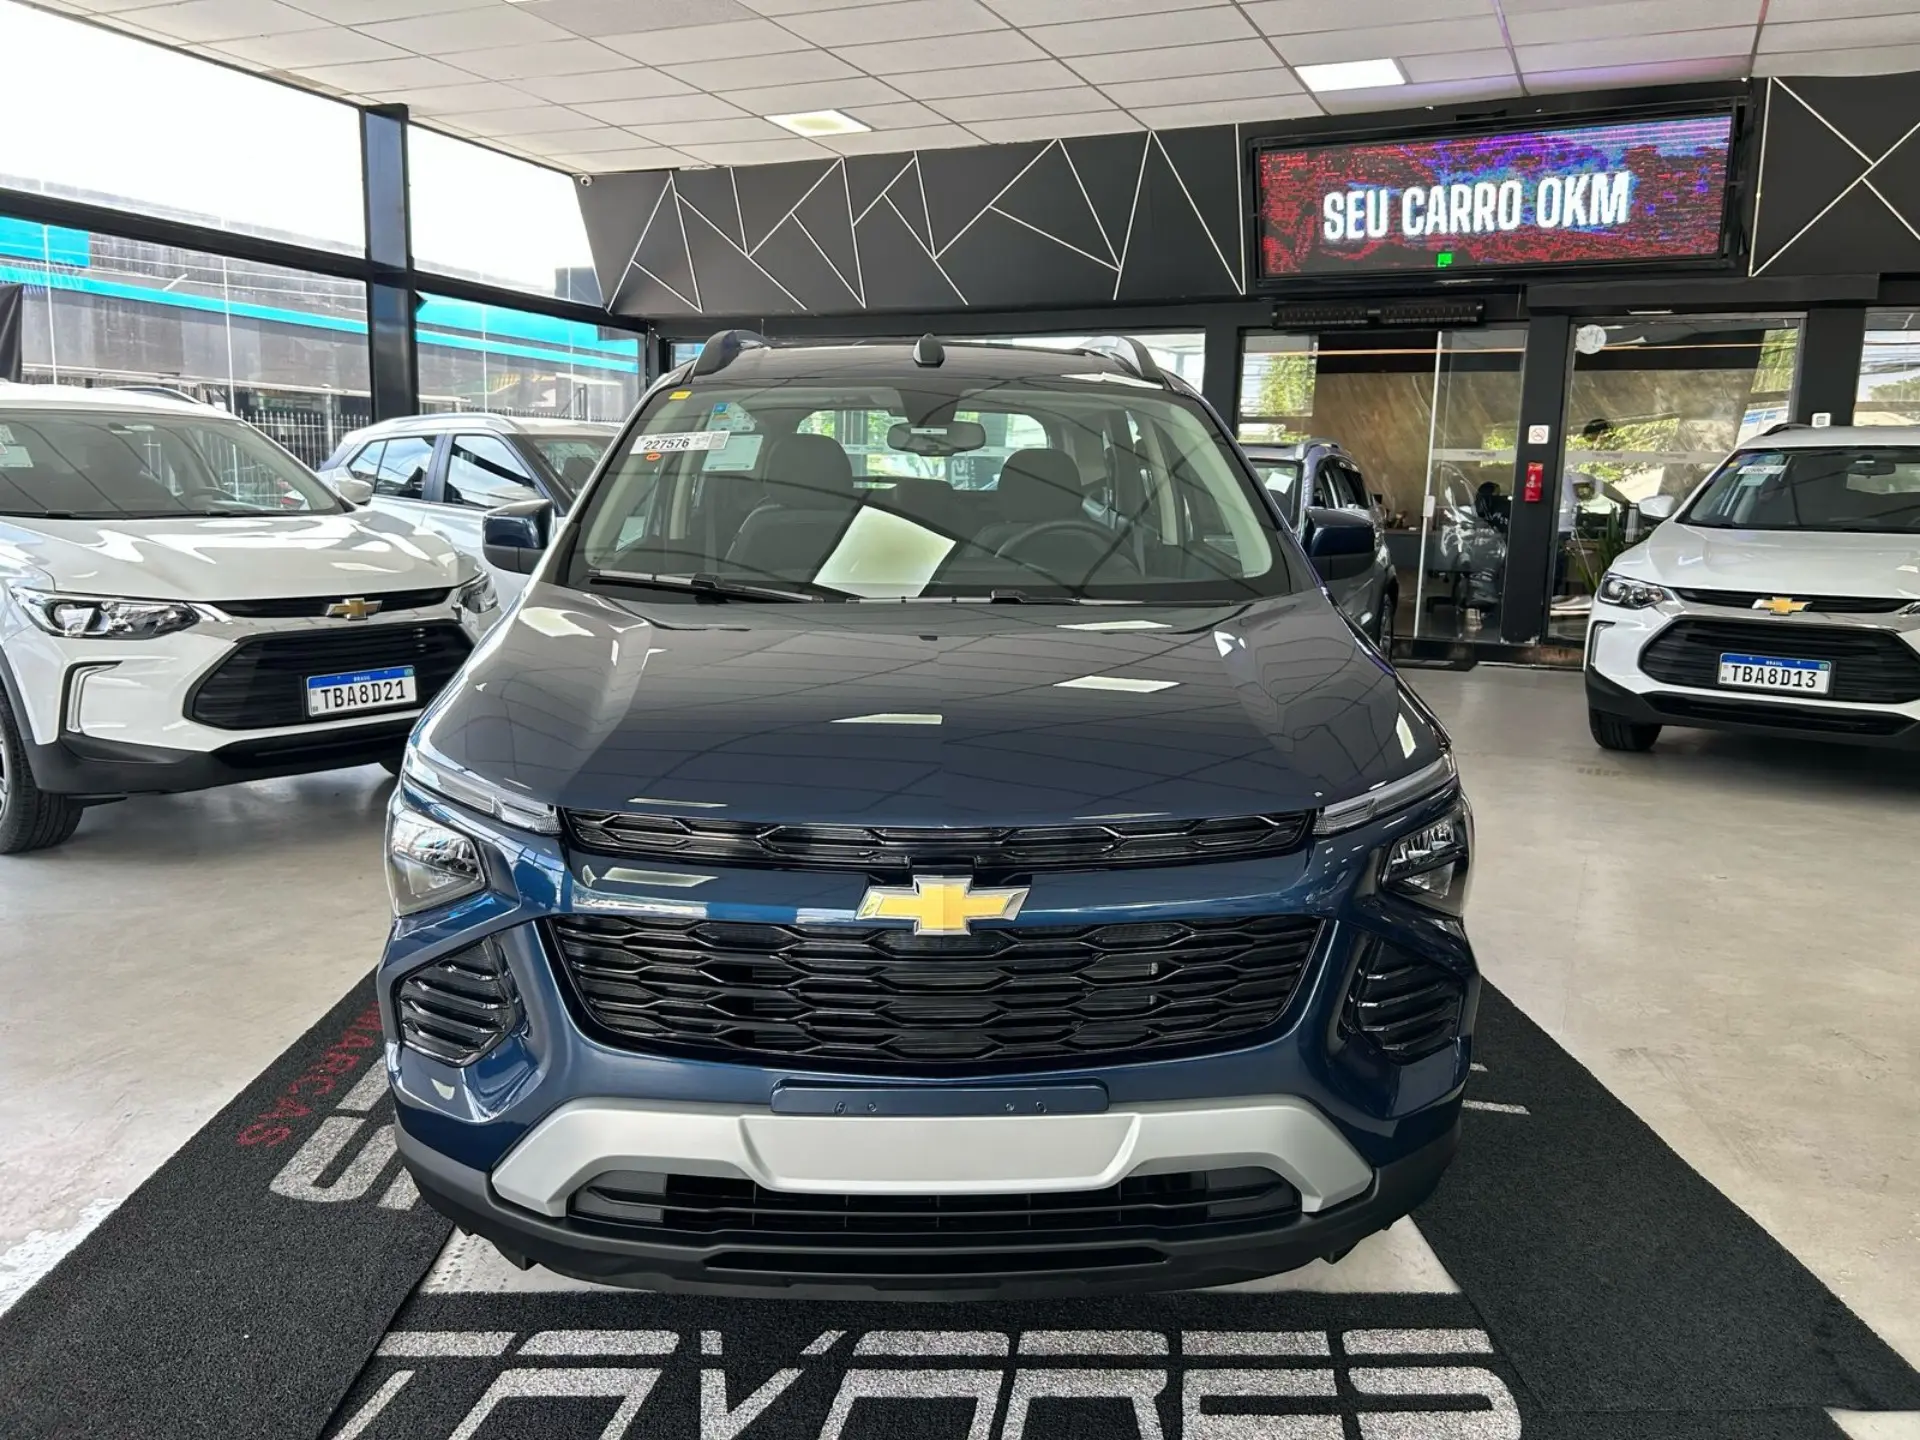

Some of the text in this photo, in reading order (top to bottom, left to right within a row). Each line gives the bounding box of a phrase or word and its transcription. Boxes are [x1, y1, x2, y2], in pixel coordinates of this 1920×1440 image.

[1323, 189, 1389, 242] SEU
[1401, 180, 1523, 237] CARRO
[643, 438, 690, 450] 227576
[1731, 665, 1817, 689] TBA8D13
[320, 680, 406, 709] TBA8D21
